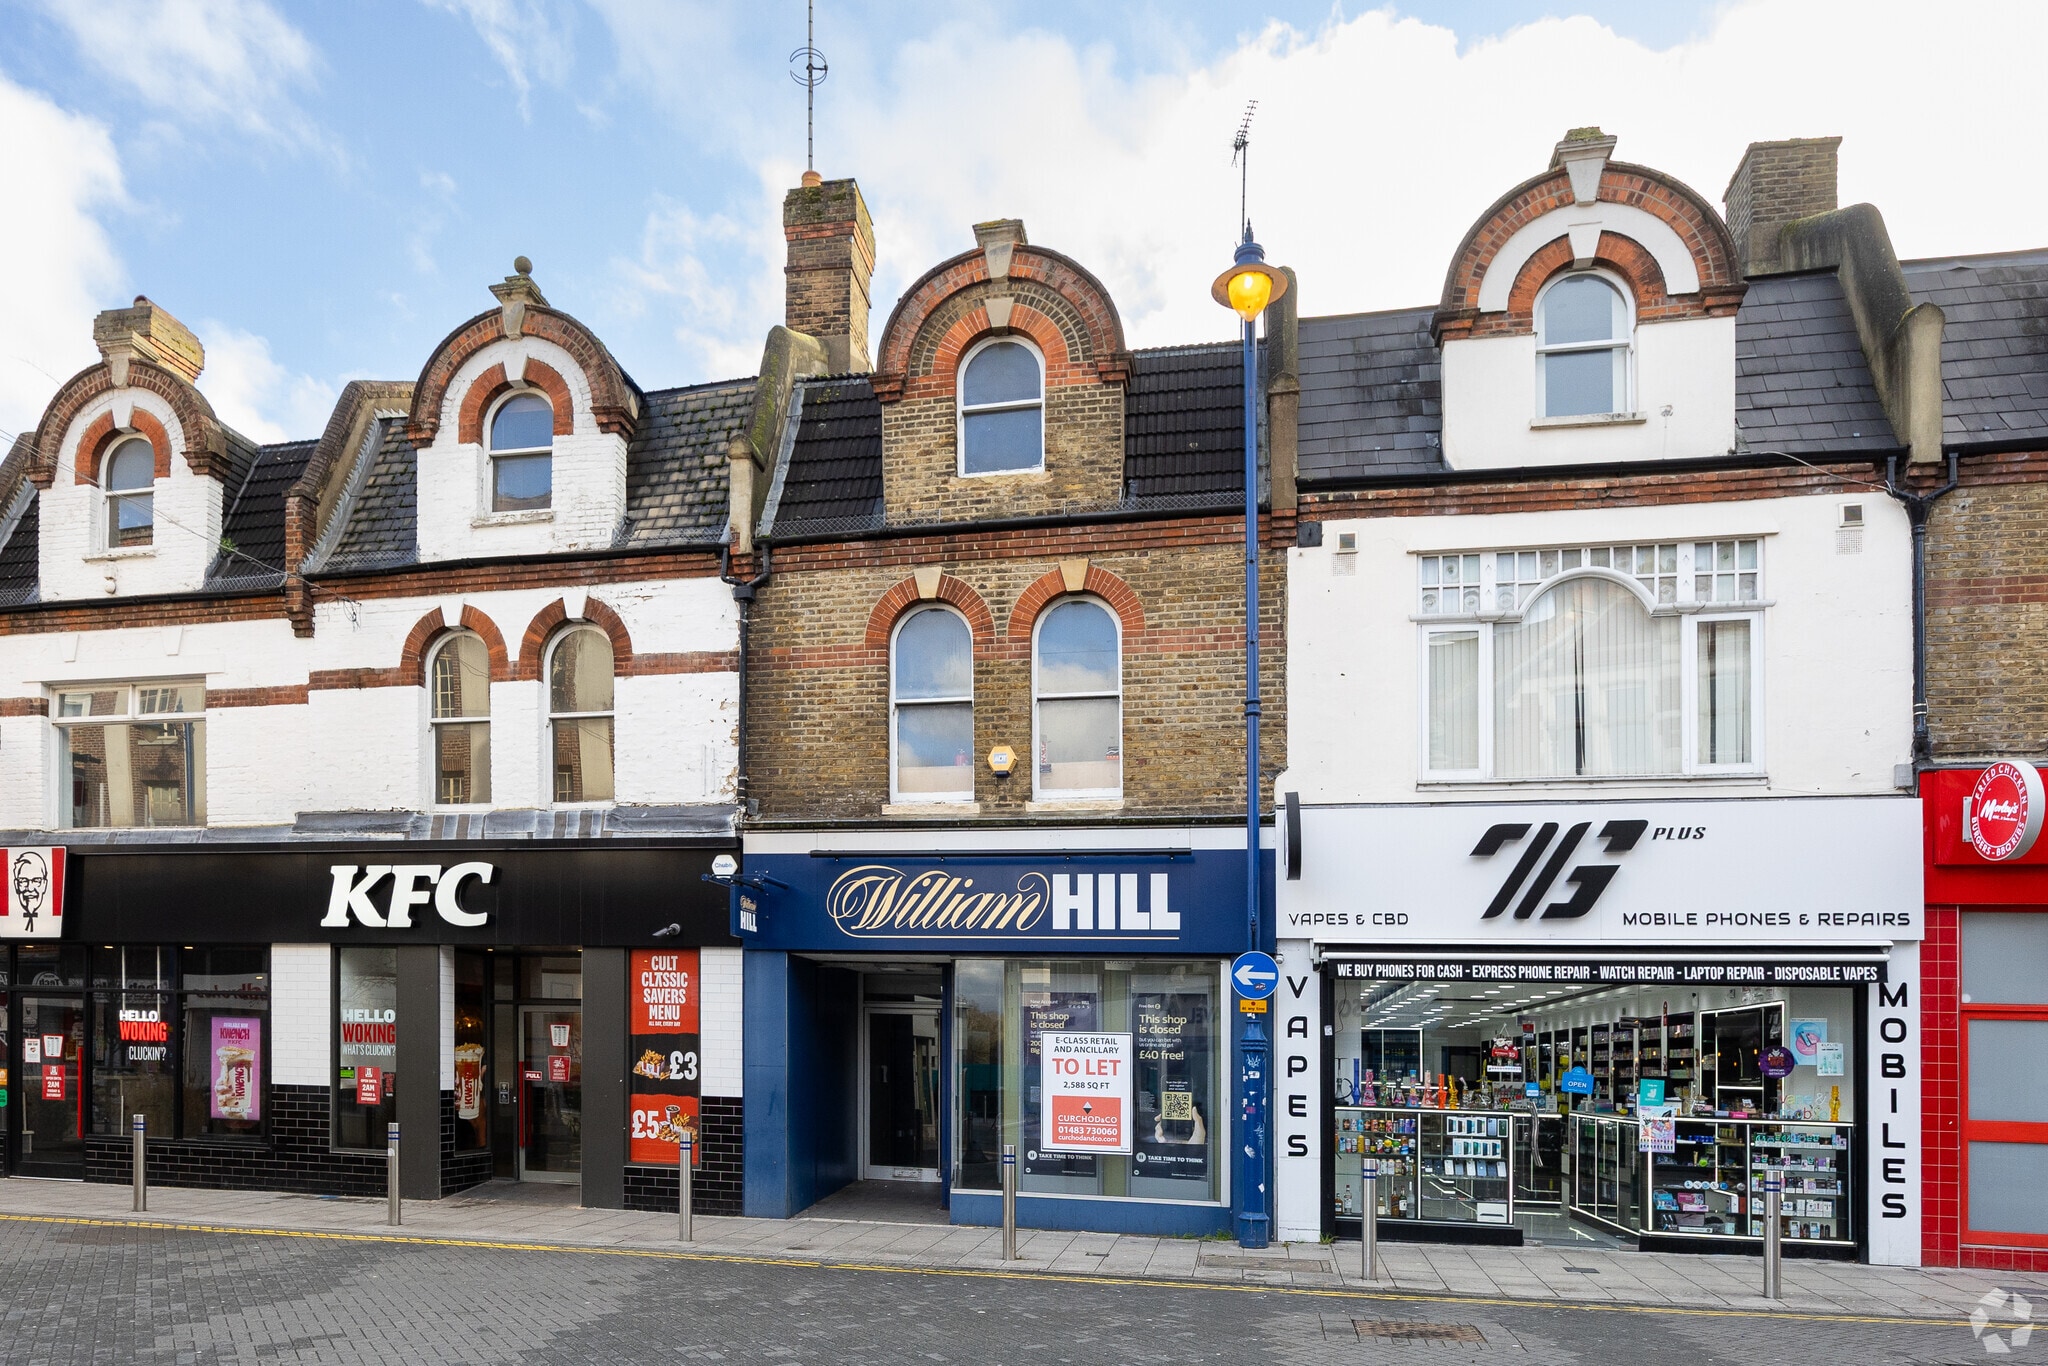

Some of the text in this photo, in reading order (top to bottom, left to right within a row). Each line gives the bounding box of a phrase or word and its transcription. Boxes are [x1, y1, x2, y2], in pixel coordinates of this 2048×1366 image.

[1975, 764, 2028, 805] FRIED CHICKEN
[1980, 799, 2019, 821] Morley's
[1651, 826, 1706, 841] PLUS
[1971, 816, 1991, 855] BURGERS
[1996, 844, 2012, 856] BBQ
[2011, 822, 2025, 846] RIBS
[320, 861, 494, 928] KFC
[827, 864, 1181, 931] William HILL
[740, 910, 757, 933] HILL
[1288, 912, 1409, 926] VAPES & CBD
[1622, 912, 1911, 926] MOBILE PHONES & REPAIRS
[651, 955, 678, 971] CULT
[1337, 963, 1353, 977] WE
[1354, 963, 1374, 977] BUY
[1375, 963, 1415, 978] PHONES
[1416, 964, 1435, 978] FOR
[1437, 964, 1463, 978] CASH
[1472, 964, 1517, 979] EXPRESS
[1519, 965, 1552, 980] PHONE
[1554, 965, 1590, 980] REPAIR
[1600, 965, 1636, 980] WATCH
[1638, 966, 1674, 980] REPAIR
[1684, 966, 1724, 980] LAPTOP
[1727, 966, 1764, 981] REPAIR
[1774, 966, 1841, 981] DISPOSABLE
[1843, 966, 1878, 981] VAPES
[641, 972, 688, 988] CLASSIC
[643, 988, 686, 1004] SAVERS
[119, 1009, 158, 1022] HELLO
[342, 1009, 396, 1023] HELLO
[649, 1005, 680, 1021] MENU
[1030, 1012, 1070, 1021] This shop
[1139, 1014, 1187, 1025] This shop
[119, 1021, 168, 1041] WOKING
[1038, 1021, 1065, 1029] closed
[1139, 1024, 1181, 1034] is closed
[342, 1023, 396, 1044] WOKING
[1055, 1037, 1118, 1045] E-CLASS RETAIL
[128, 1046, 167, 1061] CLUCKIN'?
[342, 1044, 397, 1056] WHAT'S CLUCKIN'?
[1073, 1046, 1119, 1054] ANCILLARY
[1139, 1050, 1184, 1060] £40 free!
[670, 1051, 698, 1080] £3
[1052, 1058, 1121, 1076] TO LET
[1286, 975, 1309, 1157] VAPES
[1063, 1081, 1086, 1089] 2,588
[1567, 1080, 1587, 1088] OPEN
[1878, 982, 1908, 1219] MOBILES
[632, 1110, 659, 1139] £5
[1058, 1126, 1118, 1136] 01483 730060
[1058, 1134, 1118, 1143] curchodandco.com
